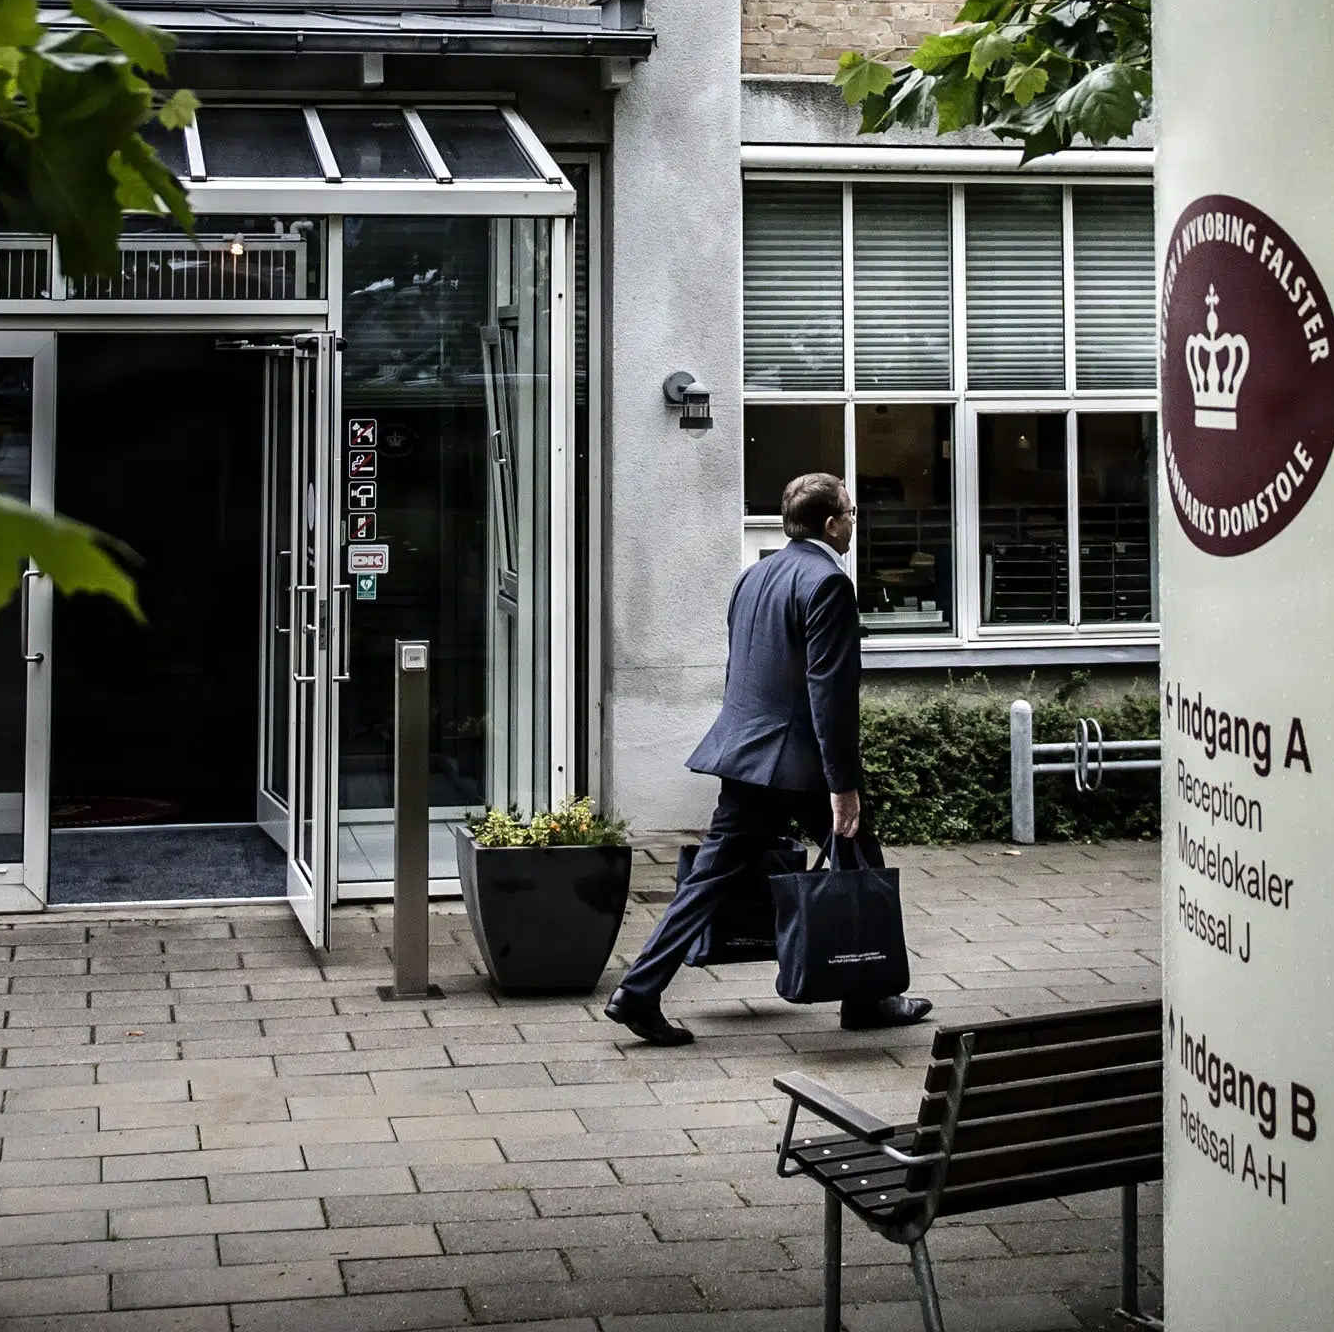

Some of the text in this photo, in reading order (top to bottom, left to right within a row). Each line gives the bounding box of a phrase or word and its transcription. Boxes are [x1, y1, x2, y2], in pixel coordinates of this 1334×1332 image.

[1182, 212, 1256, 256] NYKØBING
[1259, 235, 1330, 363] FALSTER
[1219, 441, 1314, 538] DOMSTOLE
[1177, 682, 1312, 777] Indgang A
[1178, 758, 1262, 833] Reception
[1178, 821, 1294, 910] Mødelokaler
[1179, 884, 1250, 963] Retssal J
[1180, 1015, 1317, 1142] Indgang B
[1180, 1092, 1286, 1205] Retssal A-H
